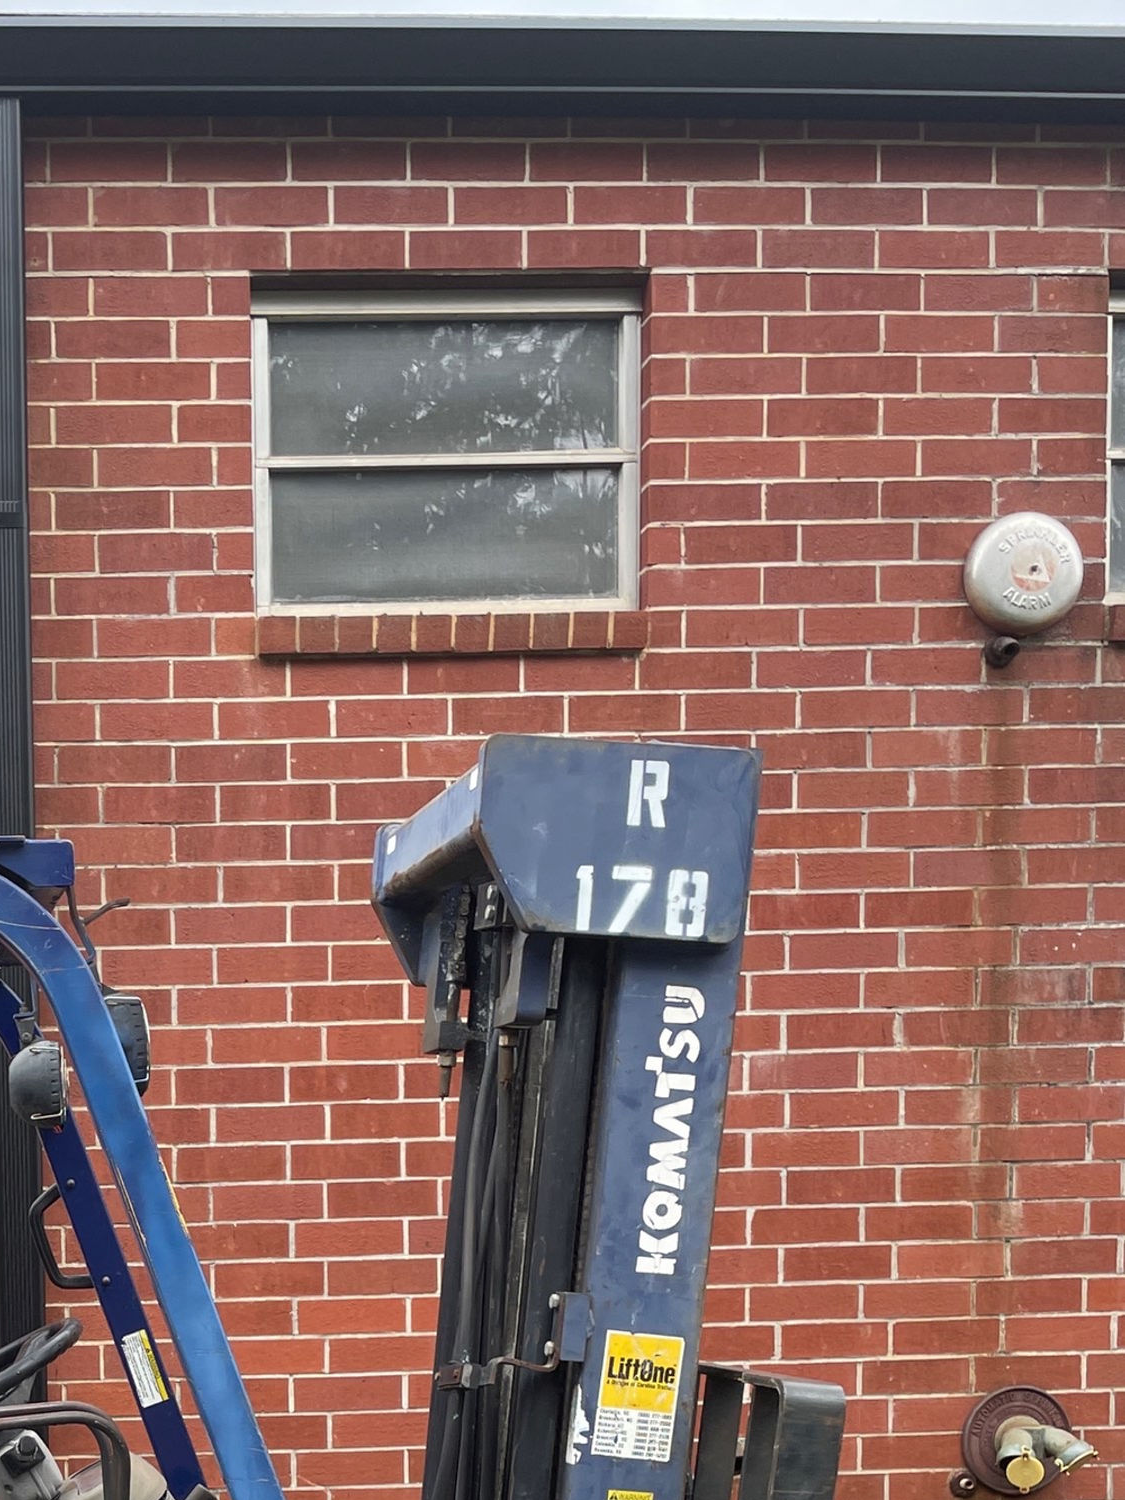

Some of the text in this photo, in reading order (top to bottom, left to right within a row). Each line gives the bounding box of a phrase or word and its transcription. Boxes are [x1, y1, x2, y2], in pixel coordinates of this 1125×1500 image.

[1003, 586, 1052, 611] ALARM
[626, 759, 670, 829] R
[574, 864, 710, 938] 178
[634, 983, 707, 1276] KOMATSU
[607, 1356, 676, 1384] LiftOne
